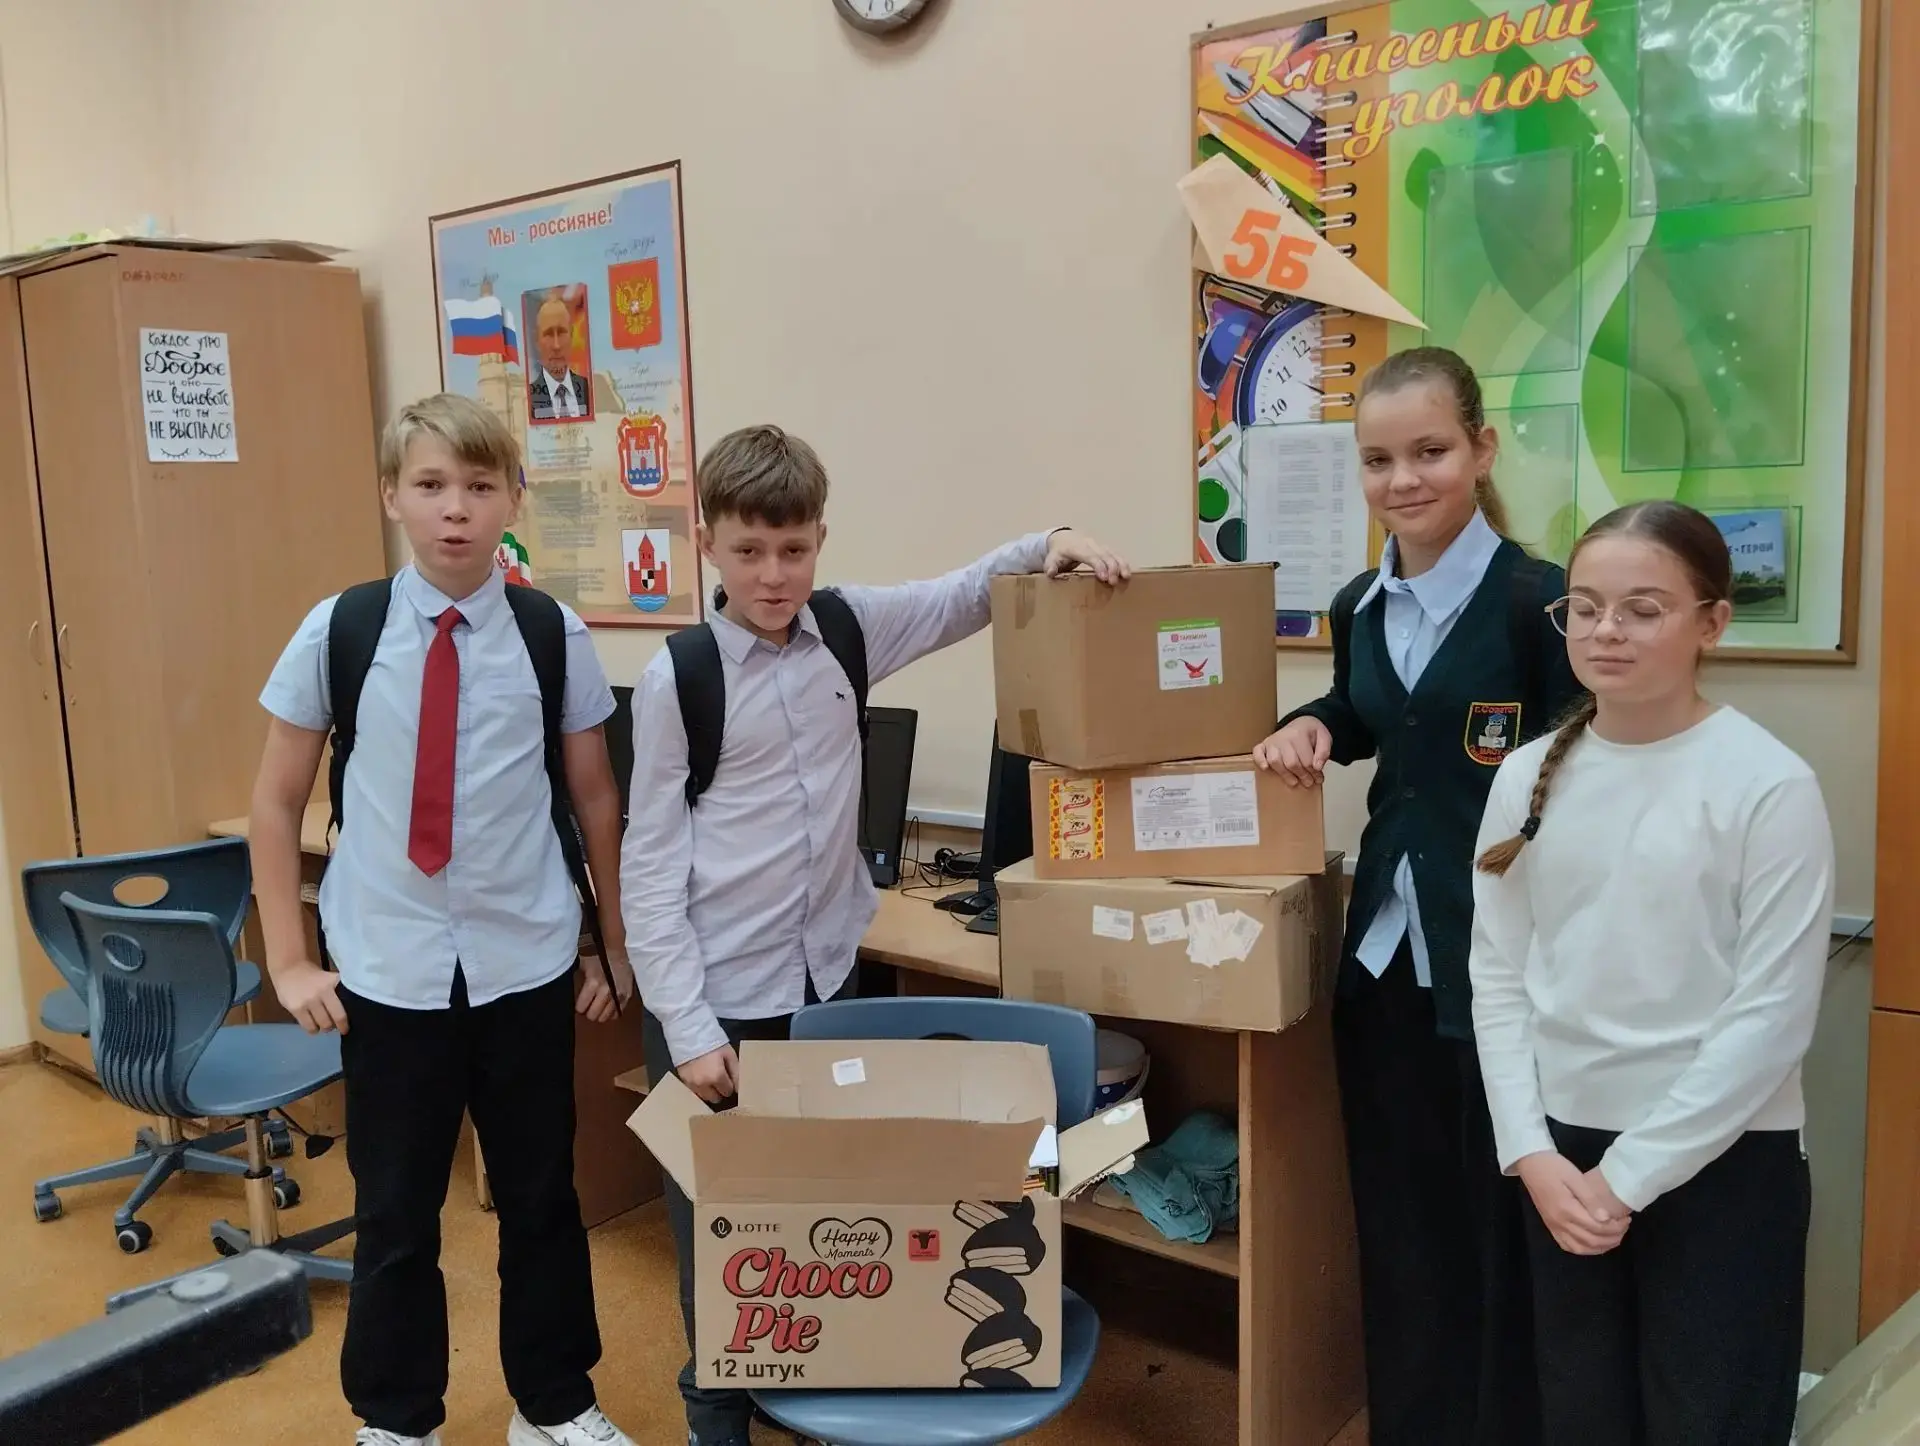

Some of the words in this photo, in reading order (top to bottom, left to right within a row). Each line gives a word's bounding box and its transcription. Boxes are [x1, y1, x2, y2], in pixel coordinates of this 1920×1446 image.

[1343, 55, 1598, 160] уголок
[487, 226, 515, 247] Мы
[529, 202, 613, 243] россияне!
[1223, 208, 1317, 291] 5Б
[1293, 339, 1311, 359] 12
[1276, 365, 1293, 384] 11
[1271, 398, 1288, 417] 10
[149, 420, 167, 439] НЕ
[169, 420, 233, 440] ВЫСПАЛСЯ
[737, 1223, 782, 1233] LOTTE
[821, 1228, 881, 1249] Happy
[823, 1248, 875, 1261] Moments
[723, 1247, 893, 1299] Choco
[724, 1303, 823, 1354] Pie
[711, 1359, 737, 1378] 12
[746, 1363, 805, 1383] штук
